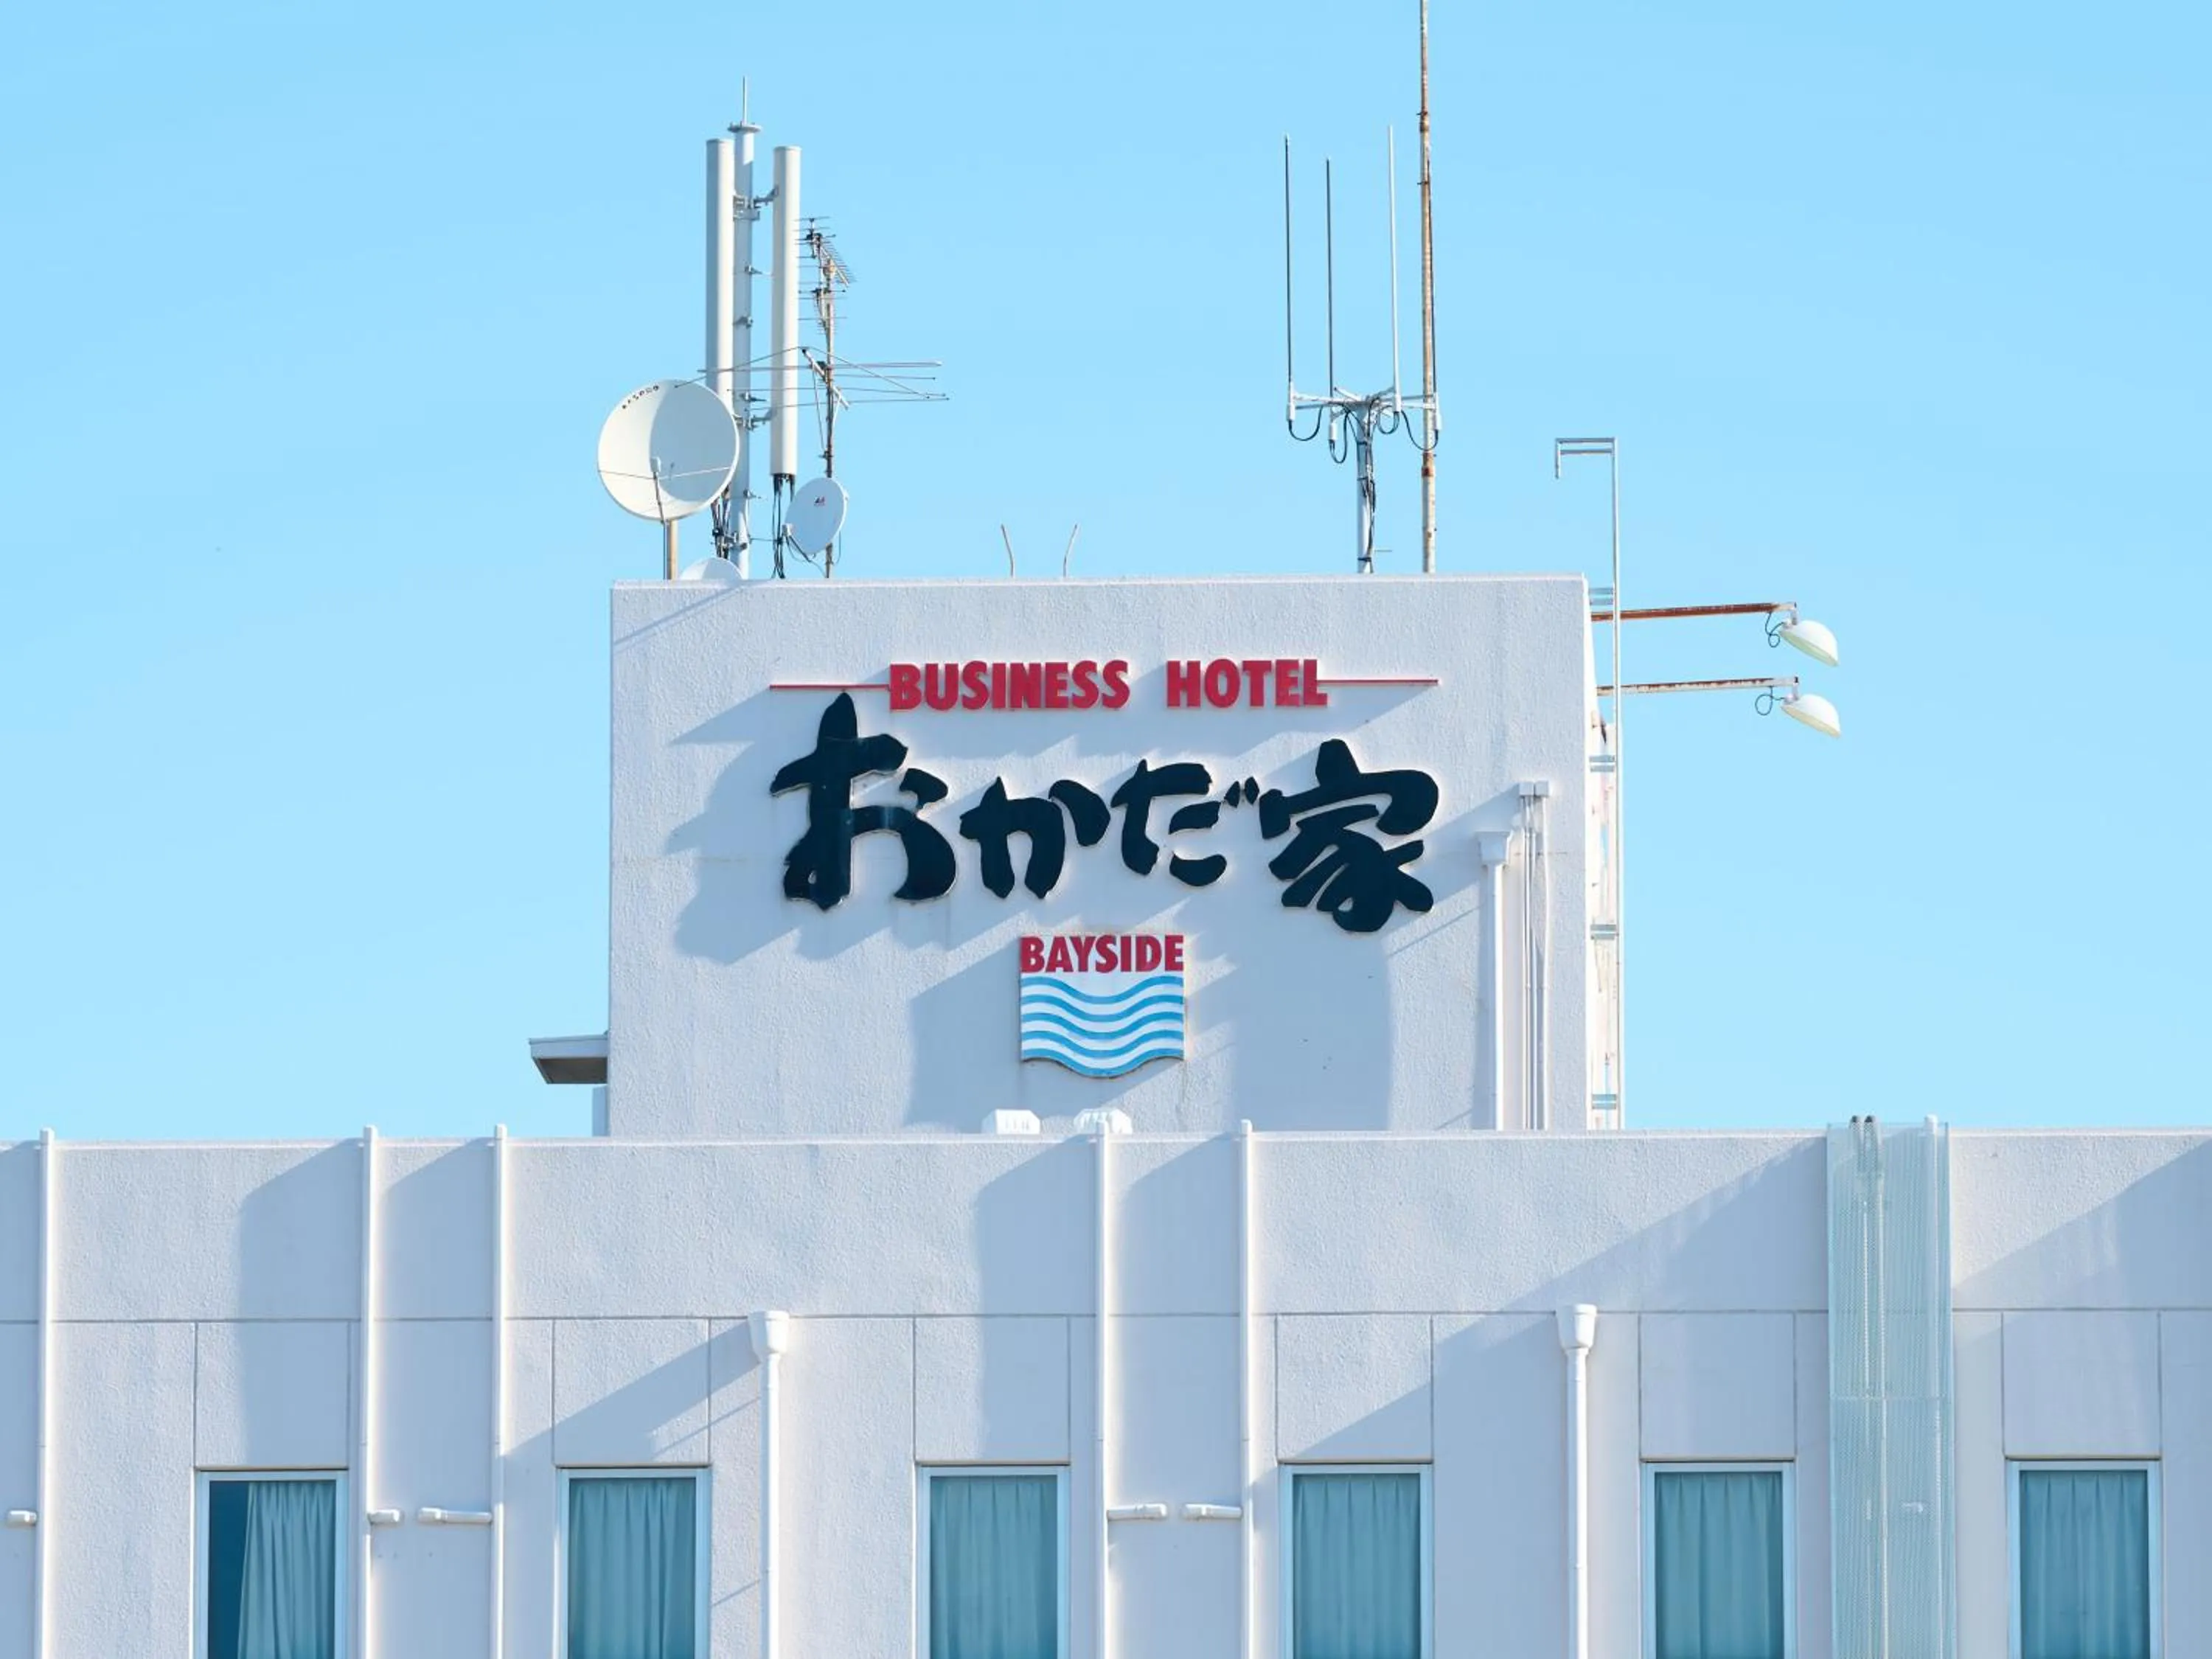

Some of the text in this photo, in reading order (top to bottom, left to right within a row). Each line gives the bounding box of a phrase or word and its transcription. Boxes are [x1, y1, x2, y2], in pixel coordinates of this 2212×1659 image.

[889, 658, 1328, 710] BUSINESS HOTEL
[769, 691, 1439, 933] おかだ家
[1020, 934, 1184, 973] BAYSIDE
